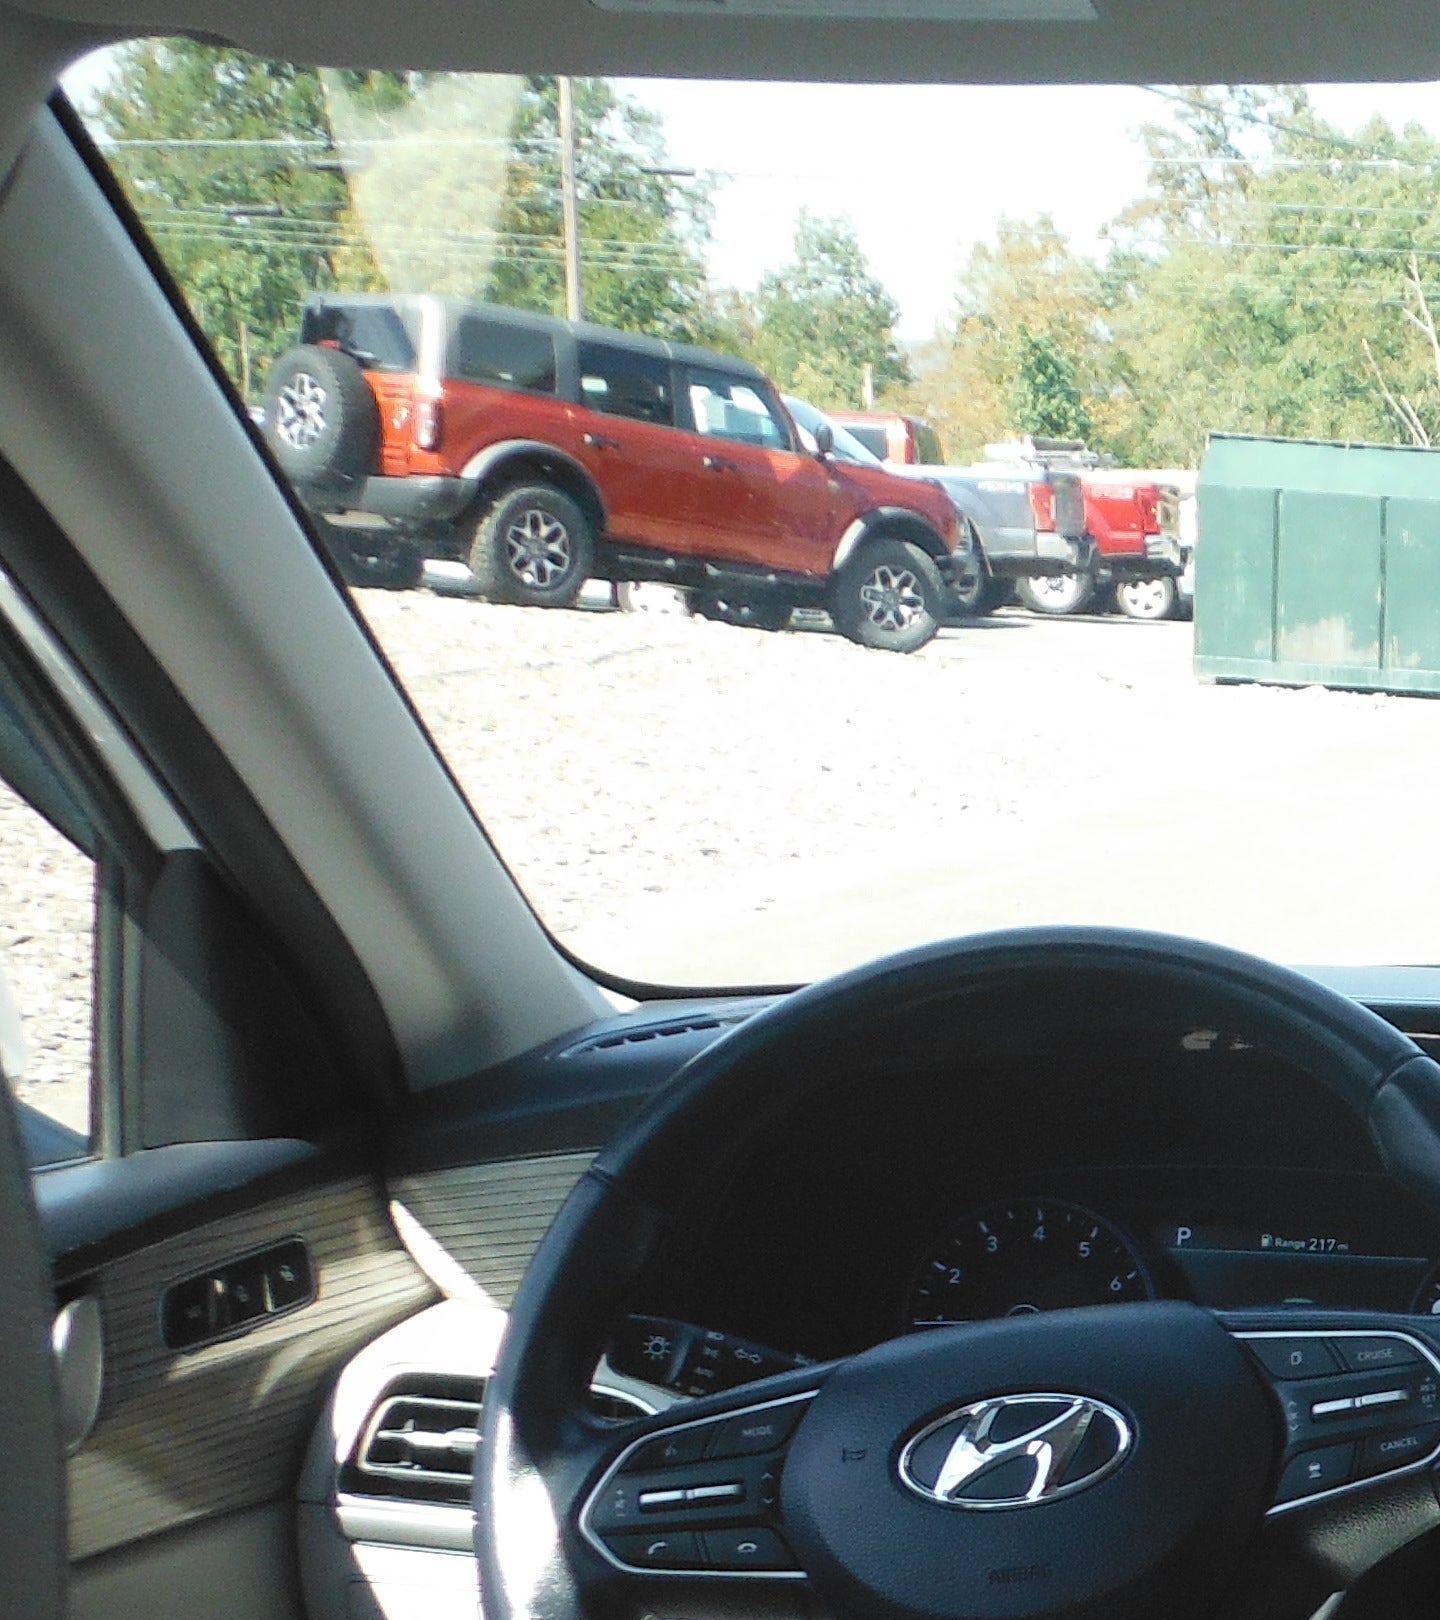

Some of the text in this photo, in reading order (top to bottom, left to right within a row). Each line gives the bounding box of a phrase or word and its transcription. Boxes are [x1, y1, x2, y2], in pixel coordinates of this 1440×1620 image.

[1032, 1226, 1046, 1241] 4
[1176, 1227, 1191, 1245] P
[987, 1236, 998, 1251] 3
[1079, 1241, 1091, 1257] 5
[1274, 1237, 1306, 1251] Range
[1309, 1238, 1337, 1251] 217
[949, 1268, 961, 1284] 2
[1110, 1276, 1122, 1291] 6
[1357, 1348, 1393, 1361] CRUISE
[742, 1425, 772, 1437] MODE
[1380, 1436, 1419, 1452] CANCEL
